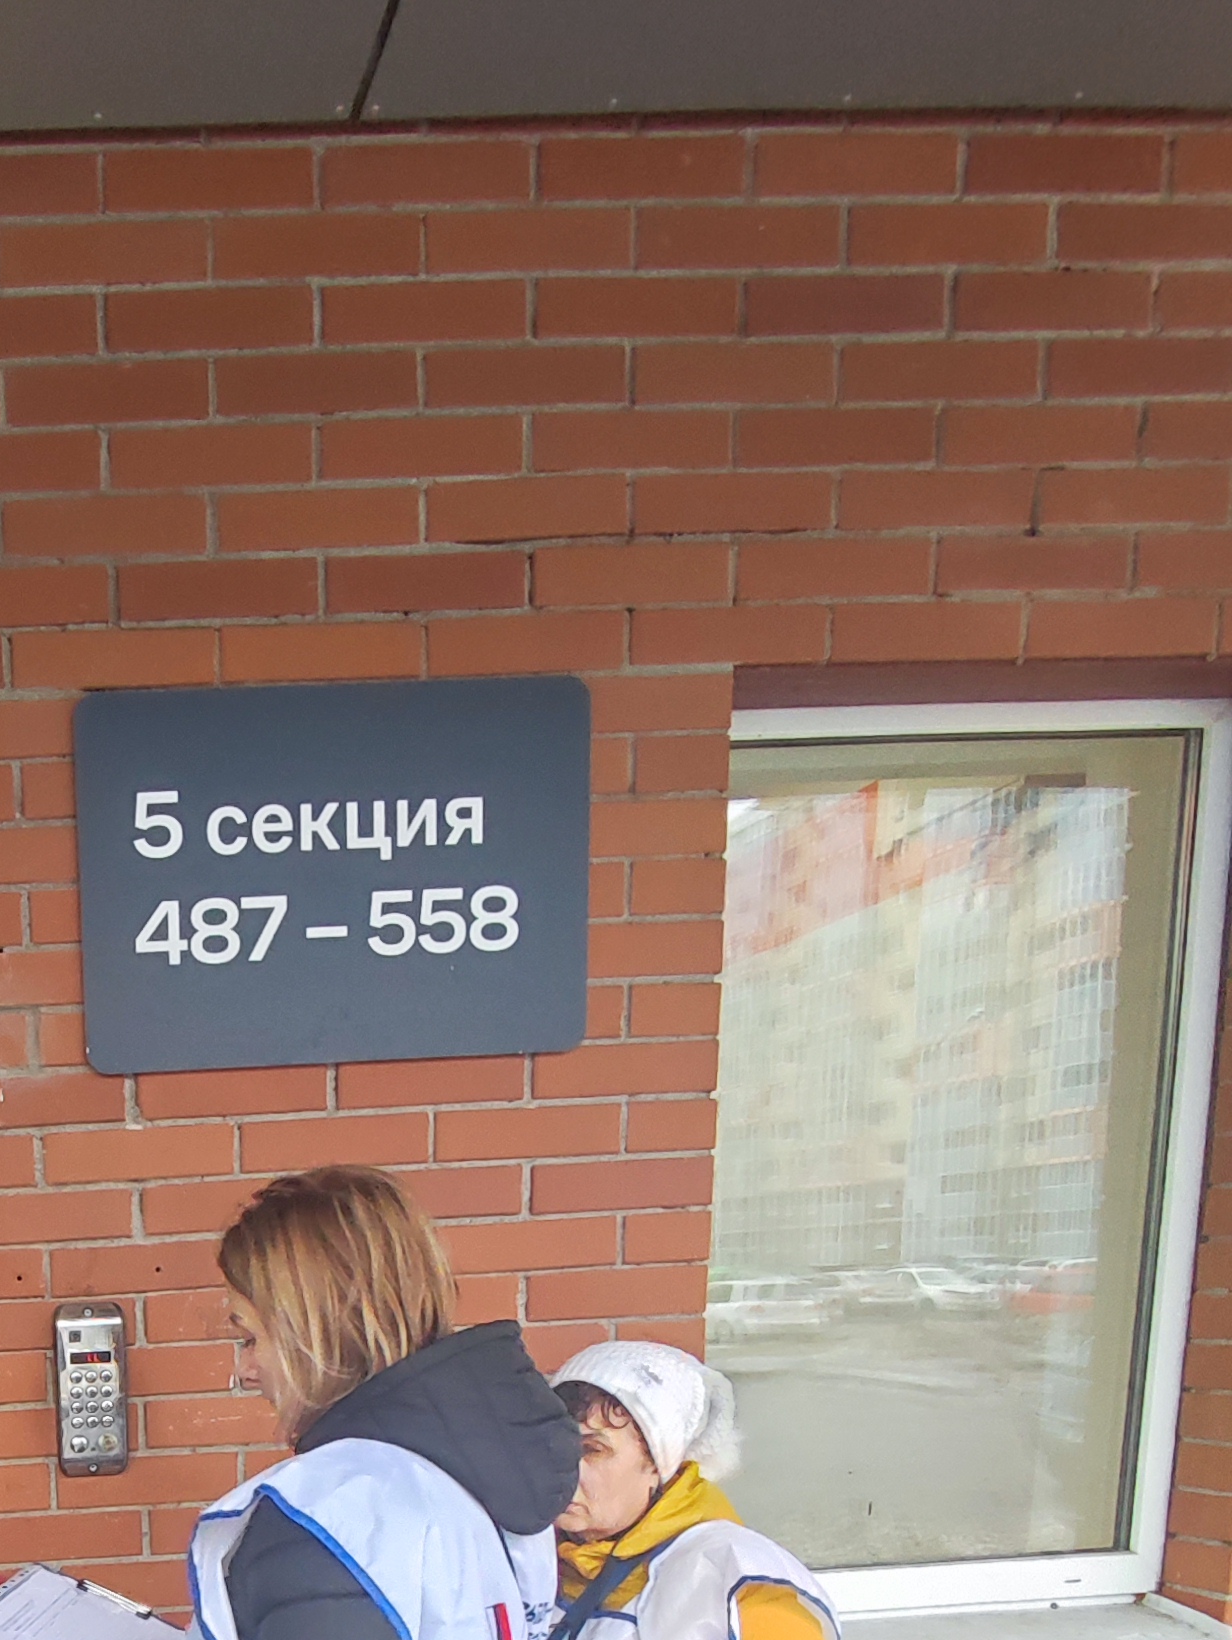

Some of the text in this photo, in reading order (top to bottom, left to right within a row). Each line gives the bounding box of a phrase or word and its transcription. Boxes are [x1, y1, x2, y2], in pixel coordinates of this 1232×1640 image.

[132, 790, 484, 861] 5 секция
[134, 894, 288, 965] 487
[367, 885, 519, 957] 558
